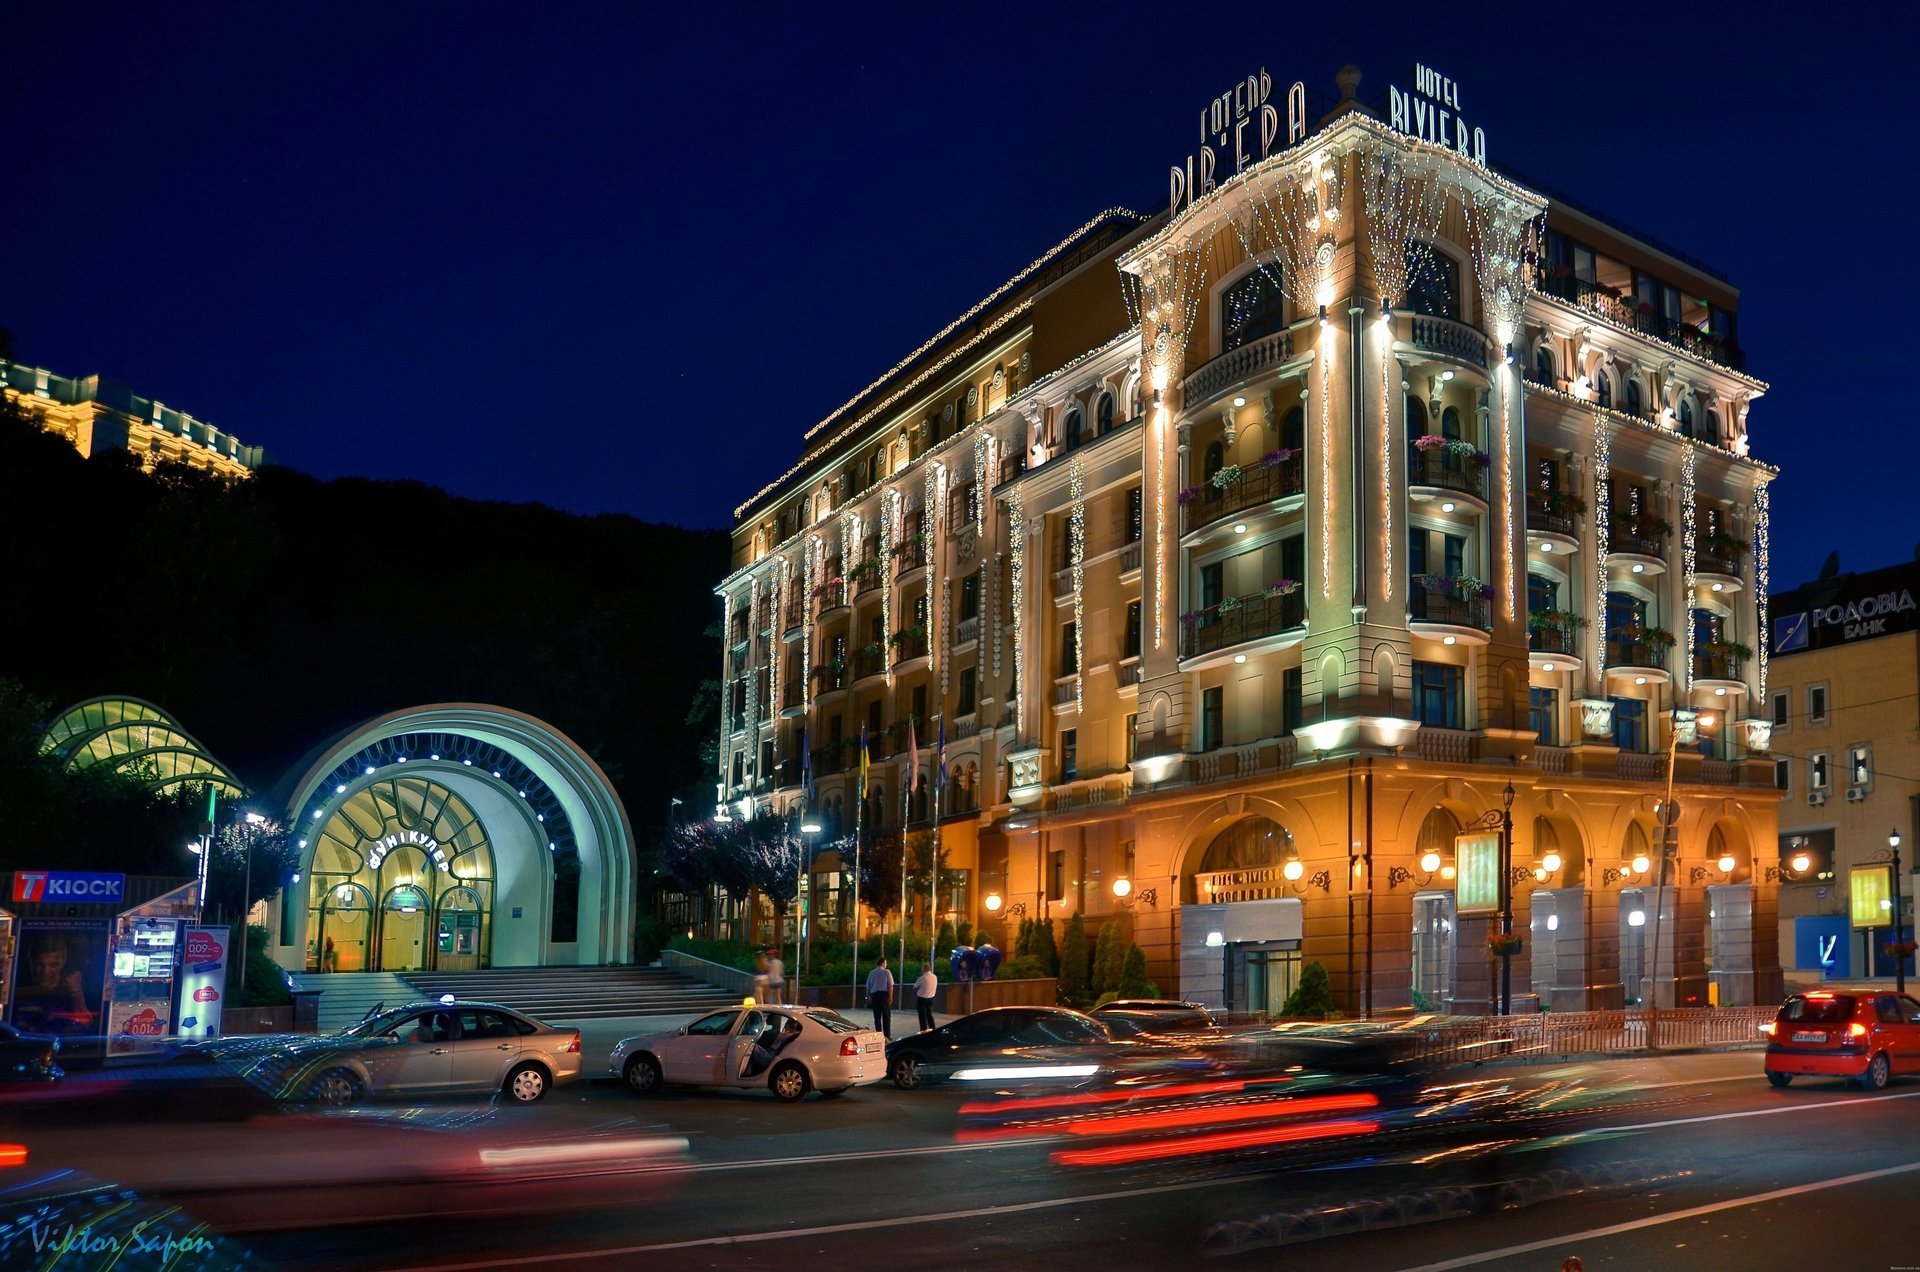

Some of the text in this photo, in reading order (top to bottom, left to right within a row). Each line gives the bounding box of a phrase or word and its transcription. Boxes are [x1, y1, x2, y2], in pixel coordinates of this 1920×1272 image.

[1416, 62, 1461, 111] HOTEL
[1390, 84, 1486, 169] RIVIERA
[1812, 589, 1917, 628] РОДОВІД
[1844, 618, 1887, 640] БАНК
[369, 830, 449, 872] ФУНІКУЛЕР
[1207, 886, 1284, 904] RESTAURANT
[1208, 873, 1235, 886] HOTEL
